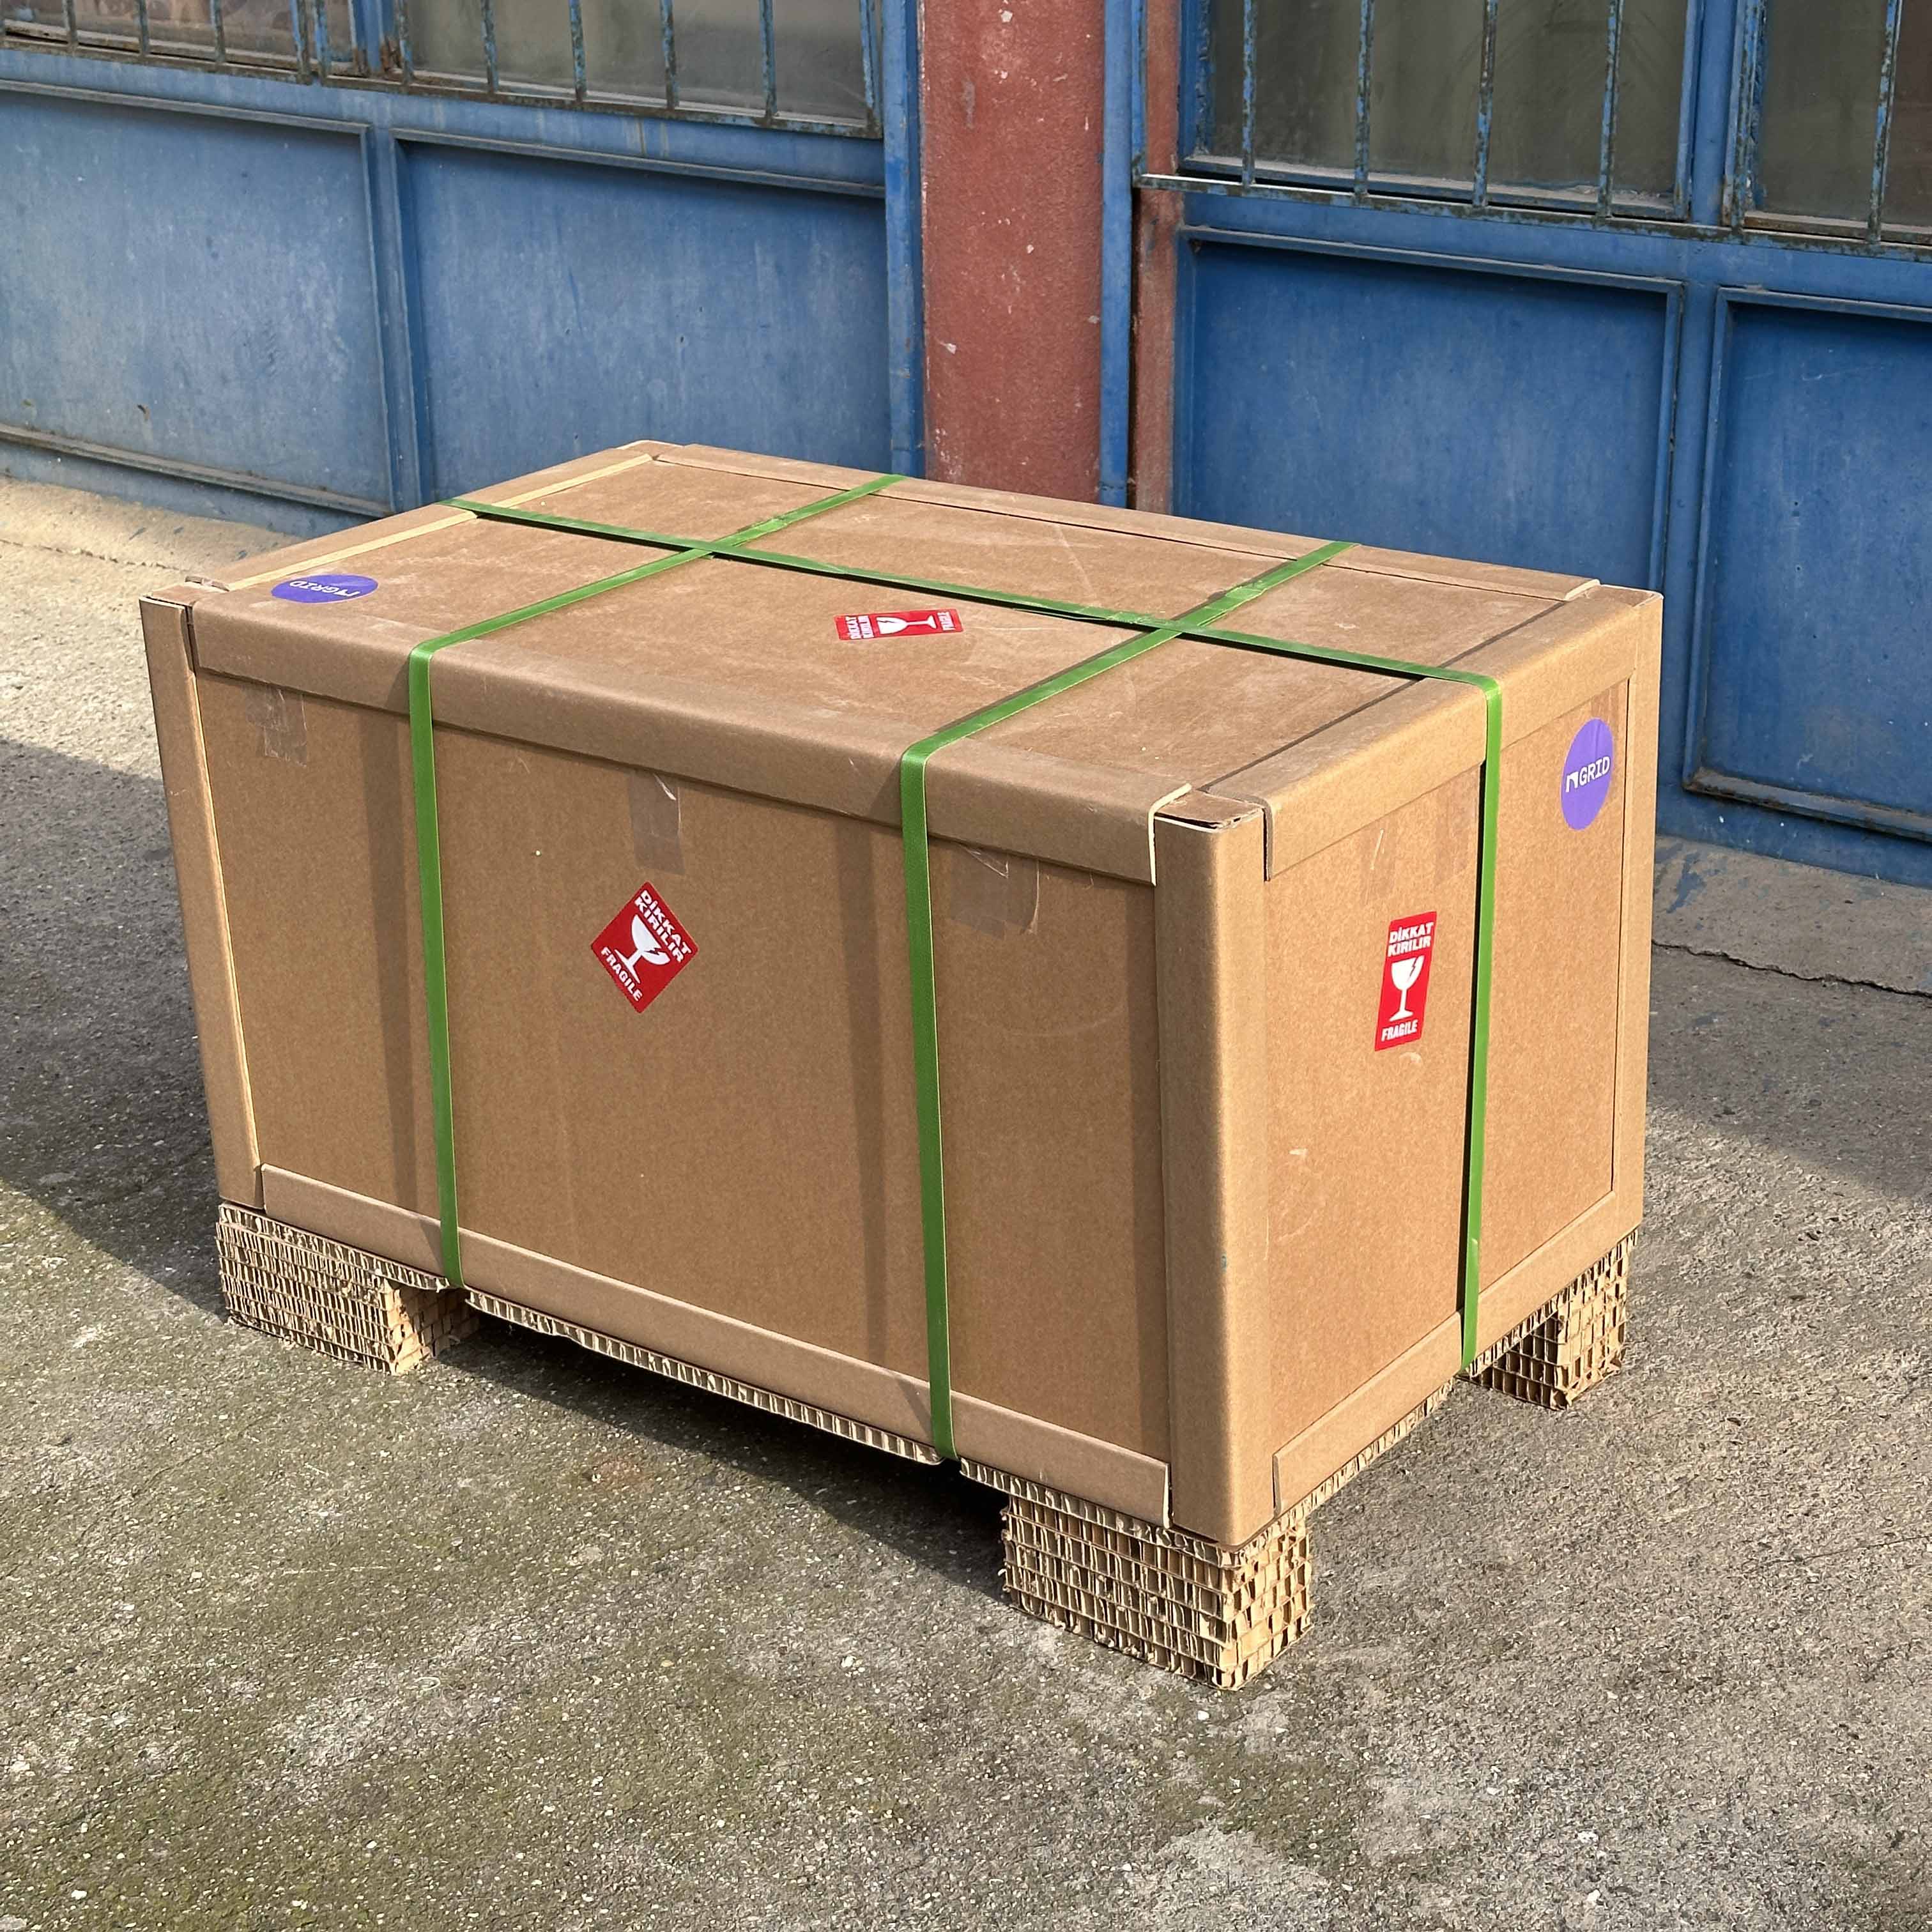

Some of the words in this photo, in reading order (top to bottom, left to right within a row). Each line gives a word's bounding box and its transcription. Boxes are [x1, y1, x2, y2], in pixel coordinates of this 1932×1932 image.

[634, 896, 684, 962] KIRILIR
[640, 890, 692, 954] DİKKAT
[1389, 921, 1434, 944] DİKKAT
[1388, 935, 1432, 957] KIRILIR
[601, 946, 643, 1002] FRAGILE
[1381, 1019, 1418, 1042] FRAGILE
